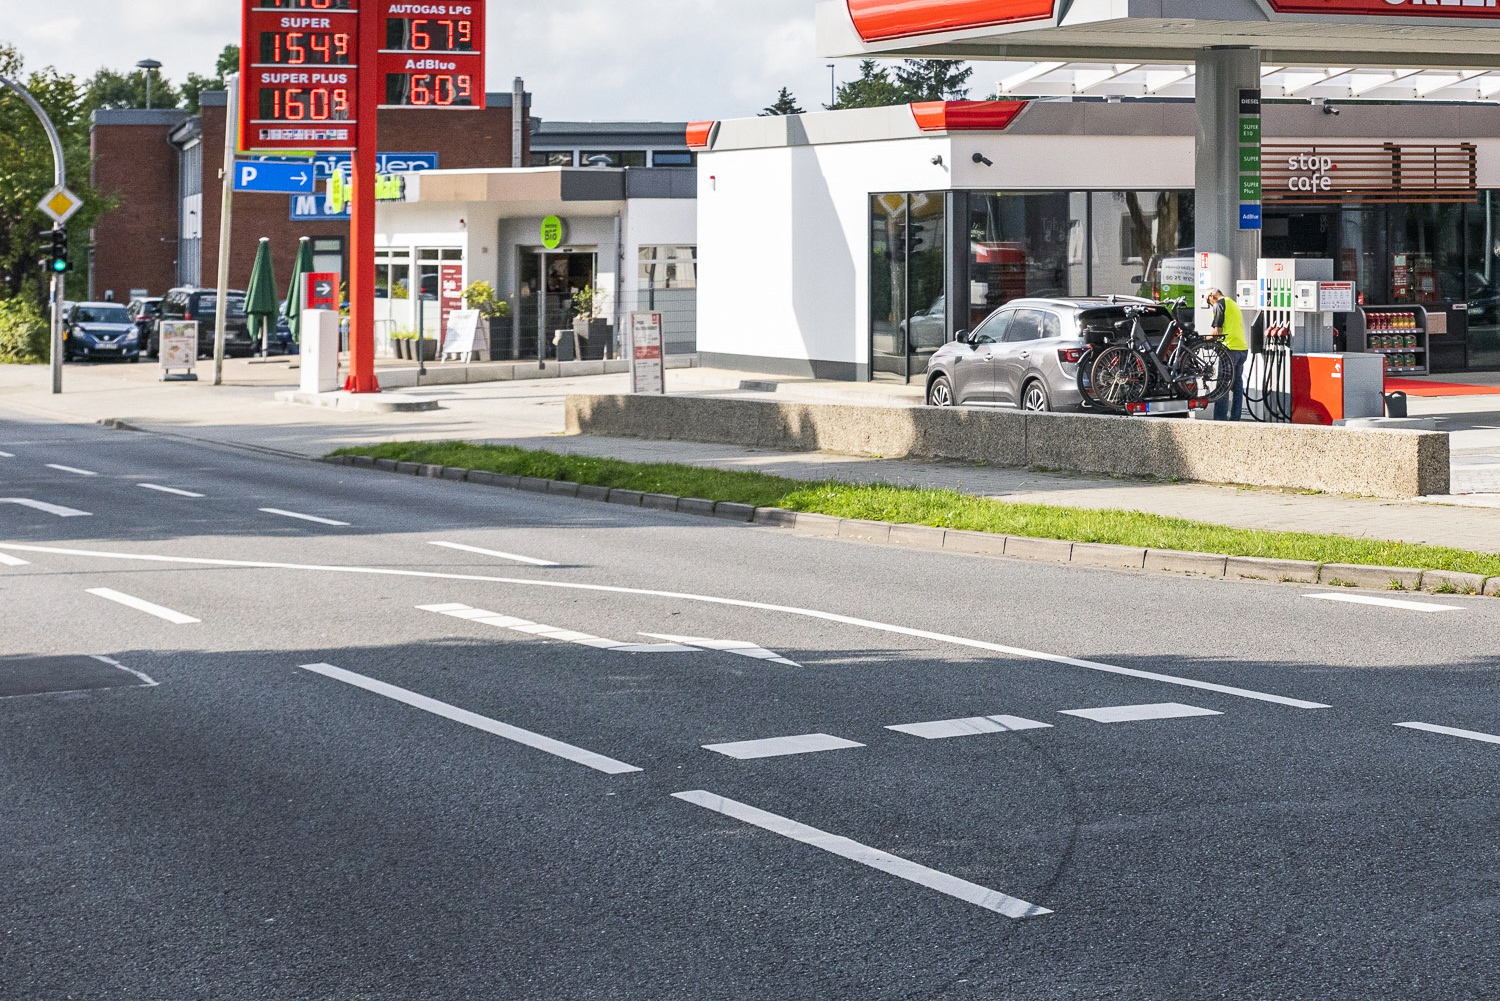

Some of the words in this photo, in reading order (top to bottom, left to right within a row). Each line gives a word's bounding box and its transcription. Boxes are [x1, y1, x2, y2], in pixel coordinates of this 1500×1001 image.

[388, 4, 447, 15] AUTOGAS
[448, 4, 472, 16] LPG
[280, 17, 330, 29] SUPER
[405, 59, 456, 70] AdBlue
[261, 73, 309, 84] SUPER
[311, 74, 348, 85] PLUS
[241, 167, 257, 186] P
[1288, 173, 1332, 193] cafe
